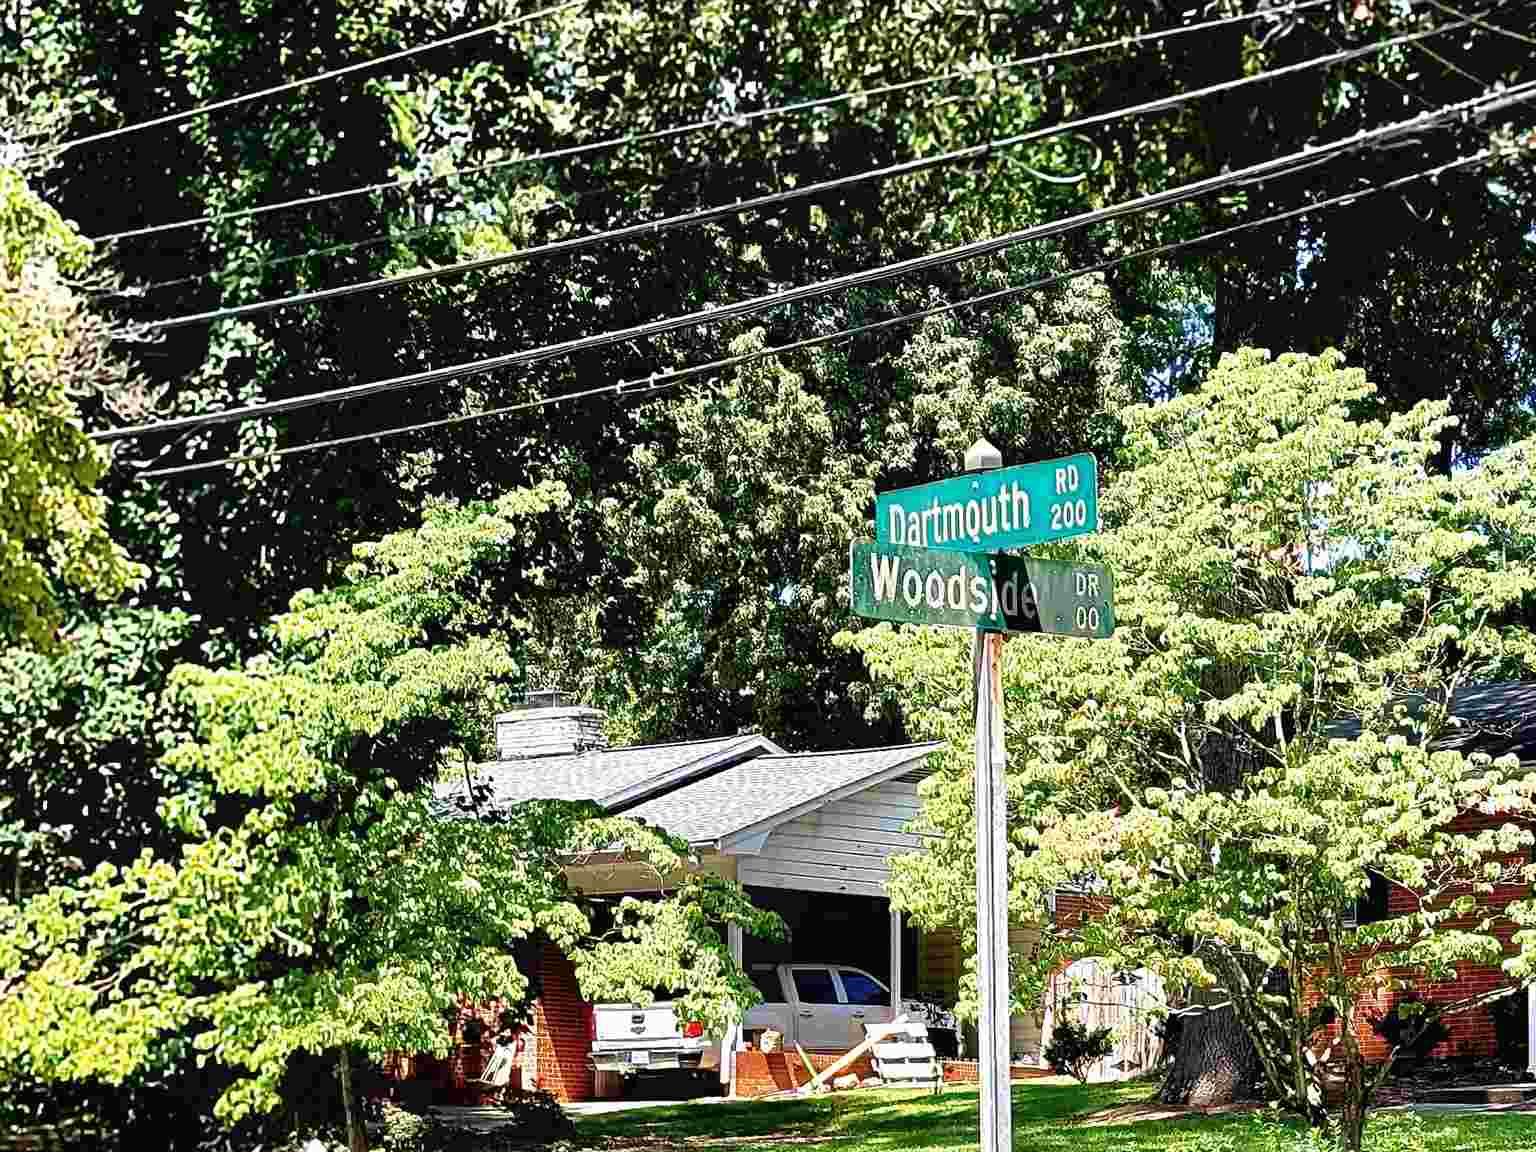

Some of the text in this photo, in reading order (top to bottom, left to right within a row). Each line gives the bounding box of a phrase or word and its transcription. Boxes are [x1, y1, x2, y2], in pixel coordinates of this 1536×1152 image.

[888, 464, 1079, 545] Dartmouth RD
[1051, 500, 1086, 530] 200
[871, 552, 1099, 621] Woodside DR
[1076, 606, 1099, 631] 00
